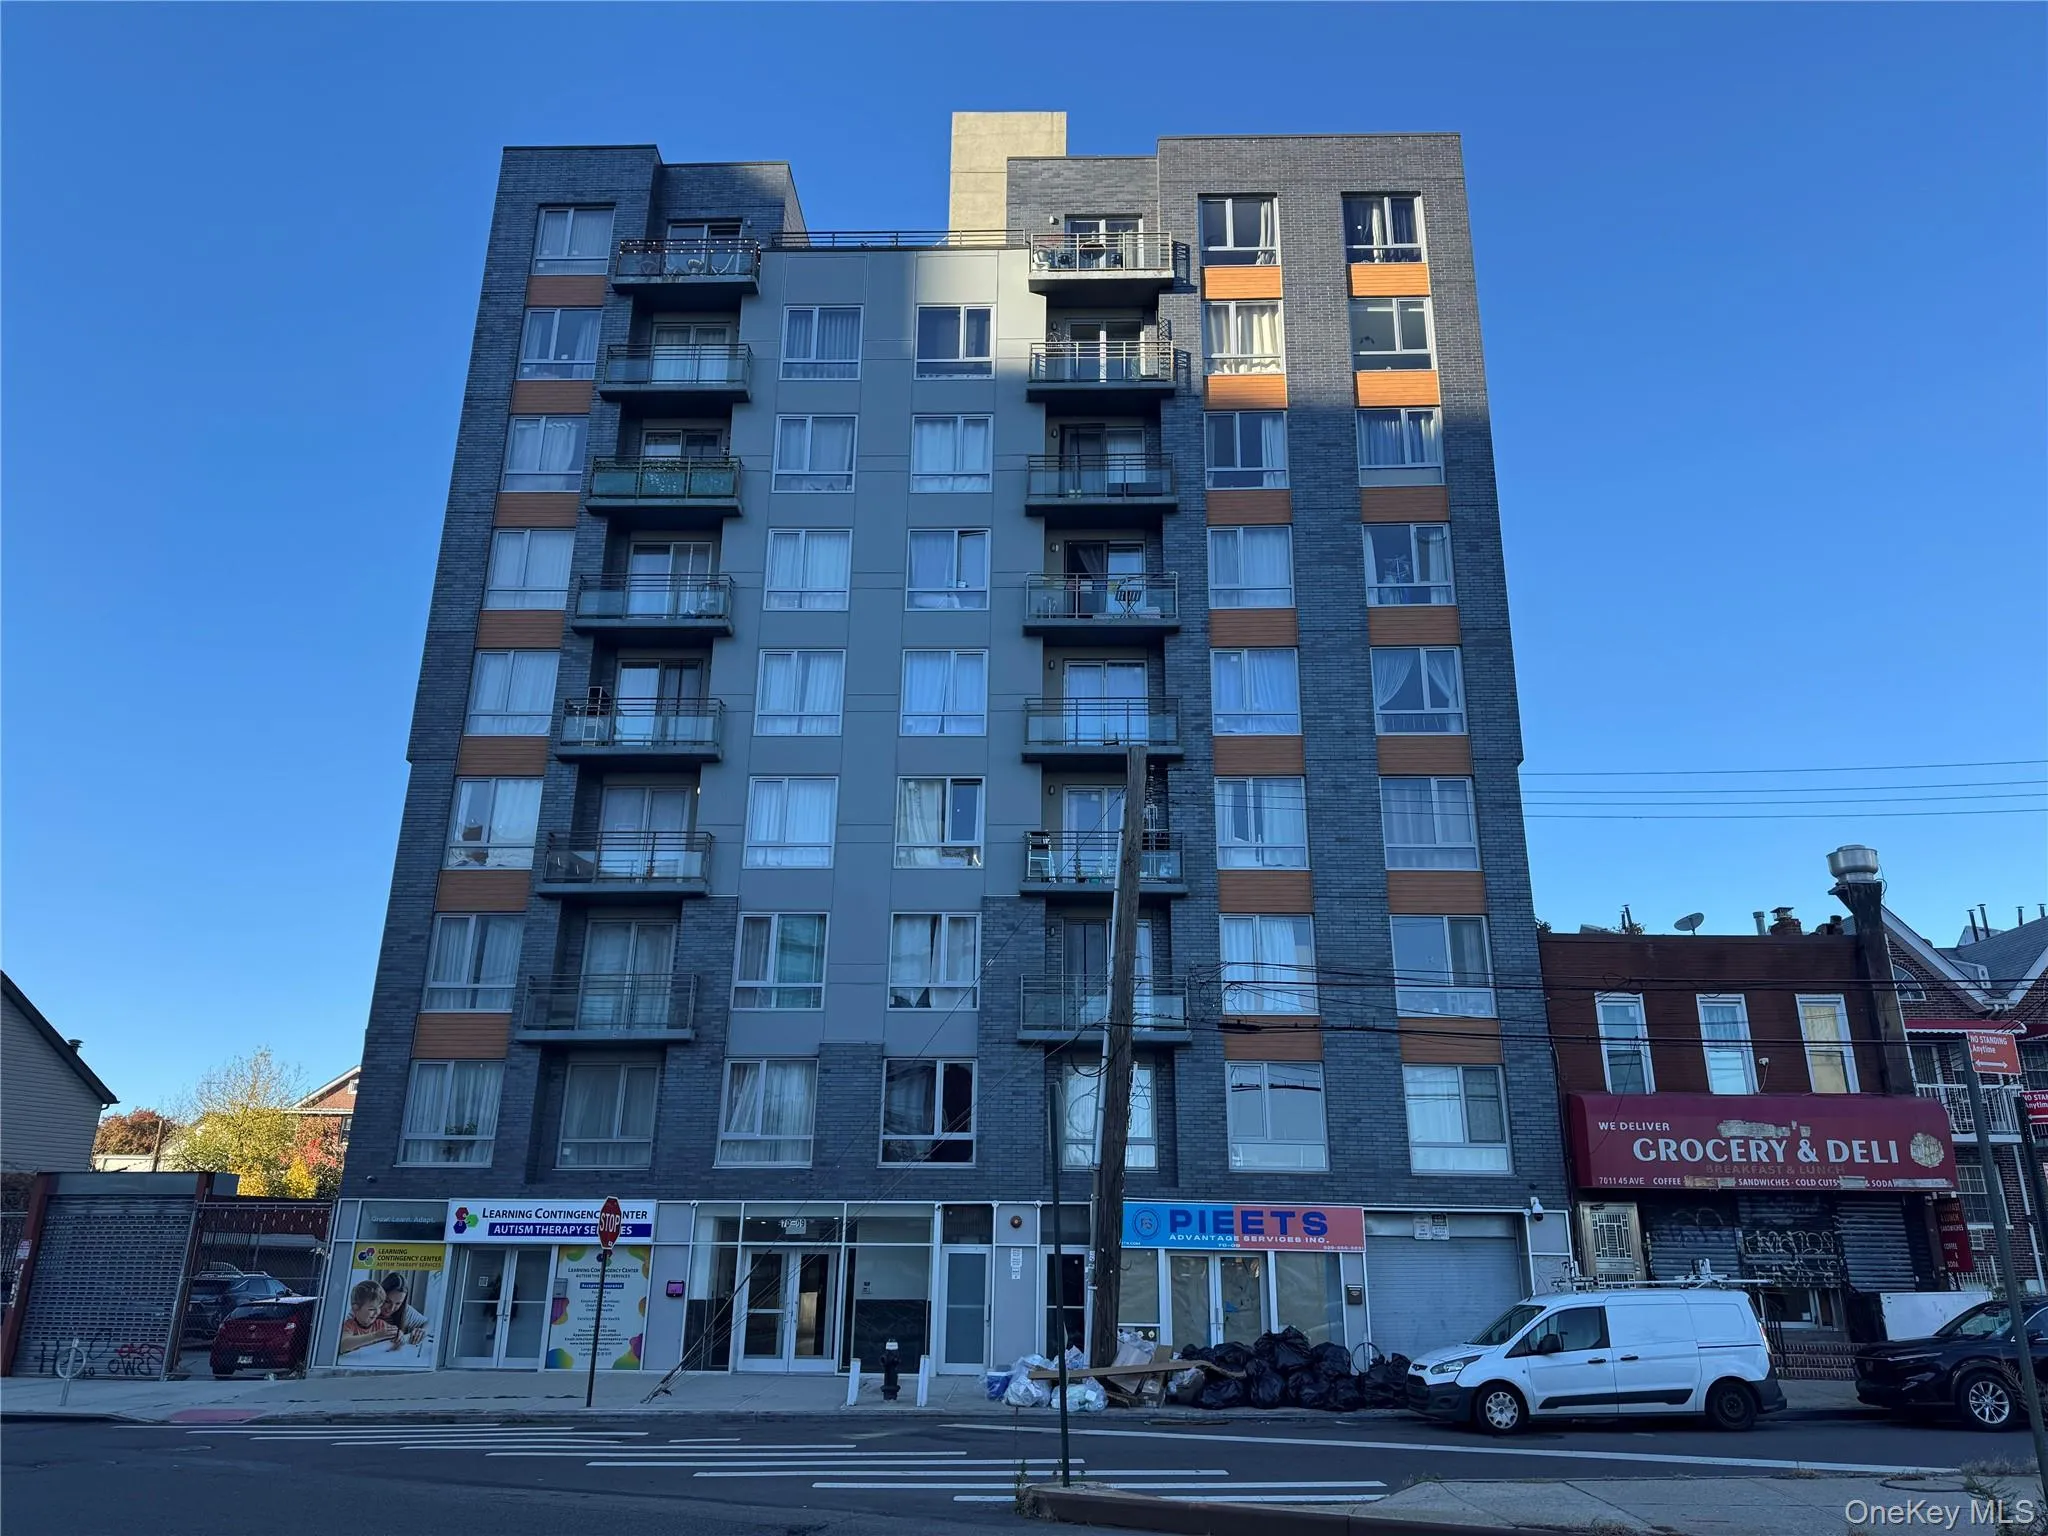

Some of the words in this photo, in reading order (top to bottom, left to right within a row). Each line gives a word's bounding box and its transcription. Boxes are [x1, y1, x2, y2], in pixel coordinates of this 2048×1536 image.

[1970, 1035, 1979, 1043] NO
[1980, 1035, 2008, 1045] STANDING
[1972, 1045, 1996, 1054] Anytime
[1599, 1122, 1617, 1131] WE
[1620, 1122, 1670, 1131] DELIVER
[1633, 1137, 1787, 1163] GROCERY
[1797, 1139, 1820, 1163] &
[1826, 1140, 1899, 1164] DELI
[1706, 1164, 1780, 1175] BREAKFAST
[1786, 1166, 1795, 1175] &
[1800, 1165, 1845, 1175] LUNCH
[1599, 1177, 1617, 1185] 7011
[1618, 1177, 1628, 1185] 45
[1629, 1177, 1645, 1185] AVE
[1653, 1177, 1681, 1185] COFFEE
[1738, 1178, 1790, 1186] SANDWICHES
[1795, 1178, 1816, 1187] COLD
[1818, 1178, 1838, 1187] CUTS
[1872, 1179, 1894, 1188] SODA
[482, 1207, 532, 1219] LEARNING
[534, 1207, 600, 1220] CONTINGENC
[622, 1209, 648, 1220] NTER
[600, 1212, 620, 1233] STOP
[1169, 1209, 1329, 1237] PIEETS
[494, 1225, 534, 1235] AUTISM
[535, 1225, 584, 1235] THERAPY
[1169, 1234, 1240, 1242] ADVANTAGE
[1243, 1235, 1302, 1243] SERVICES
[1305, 1236, 1330, 1244] INC.
